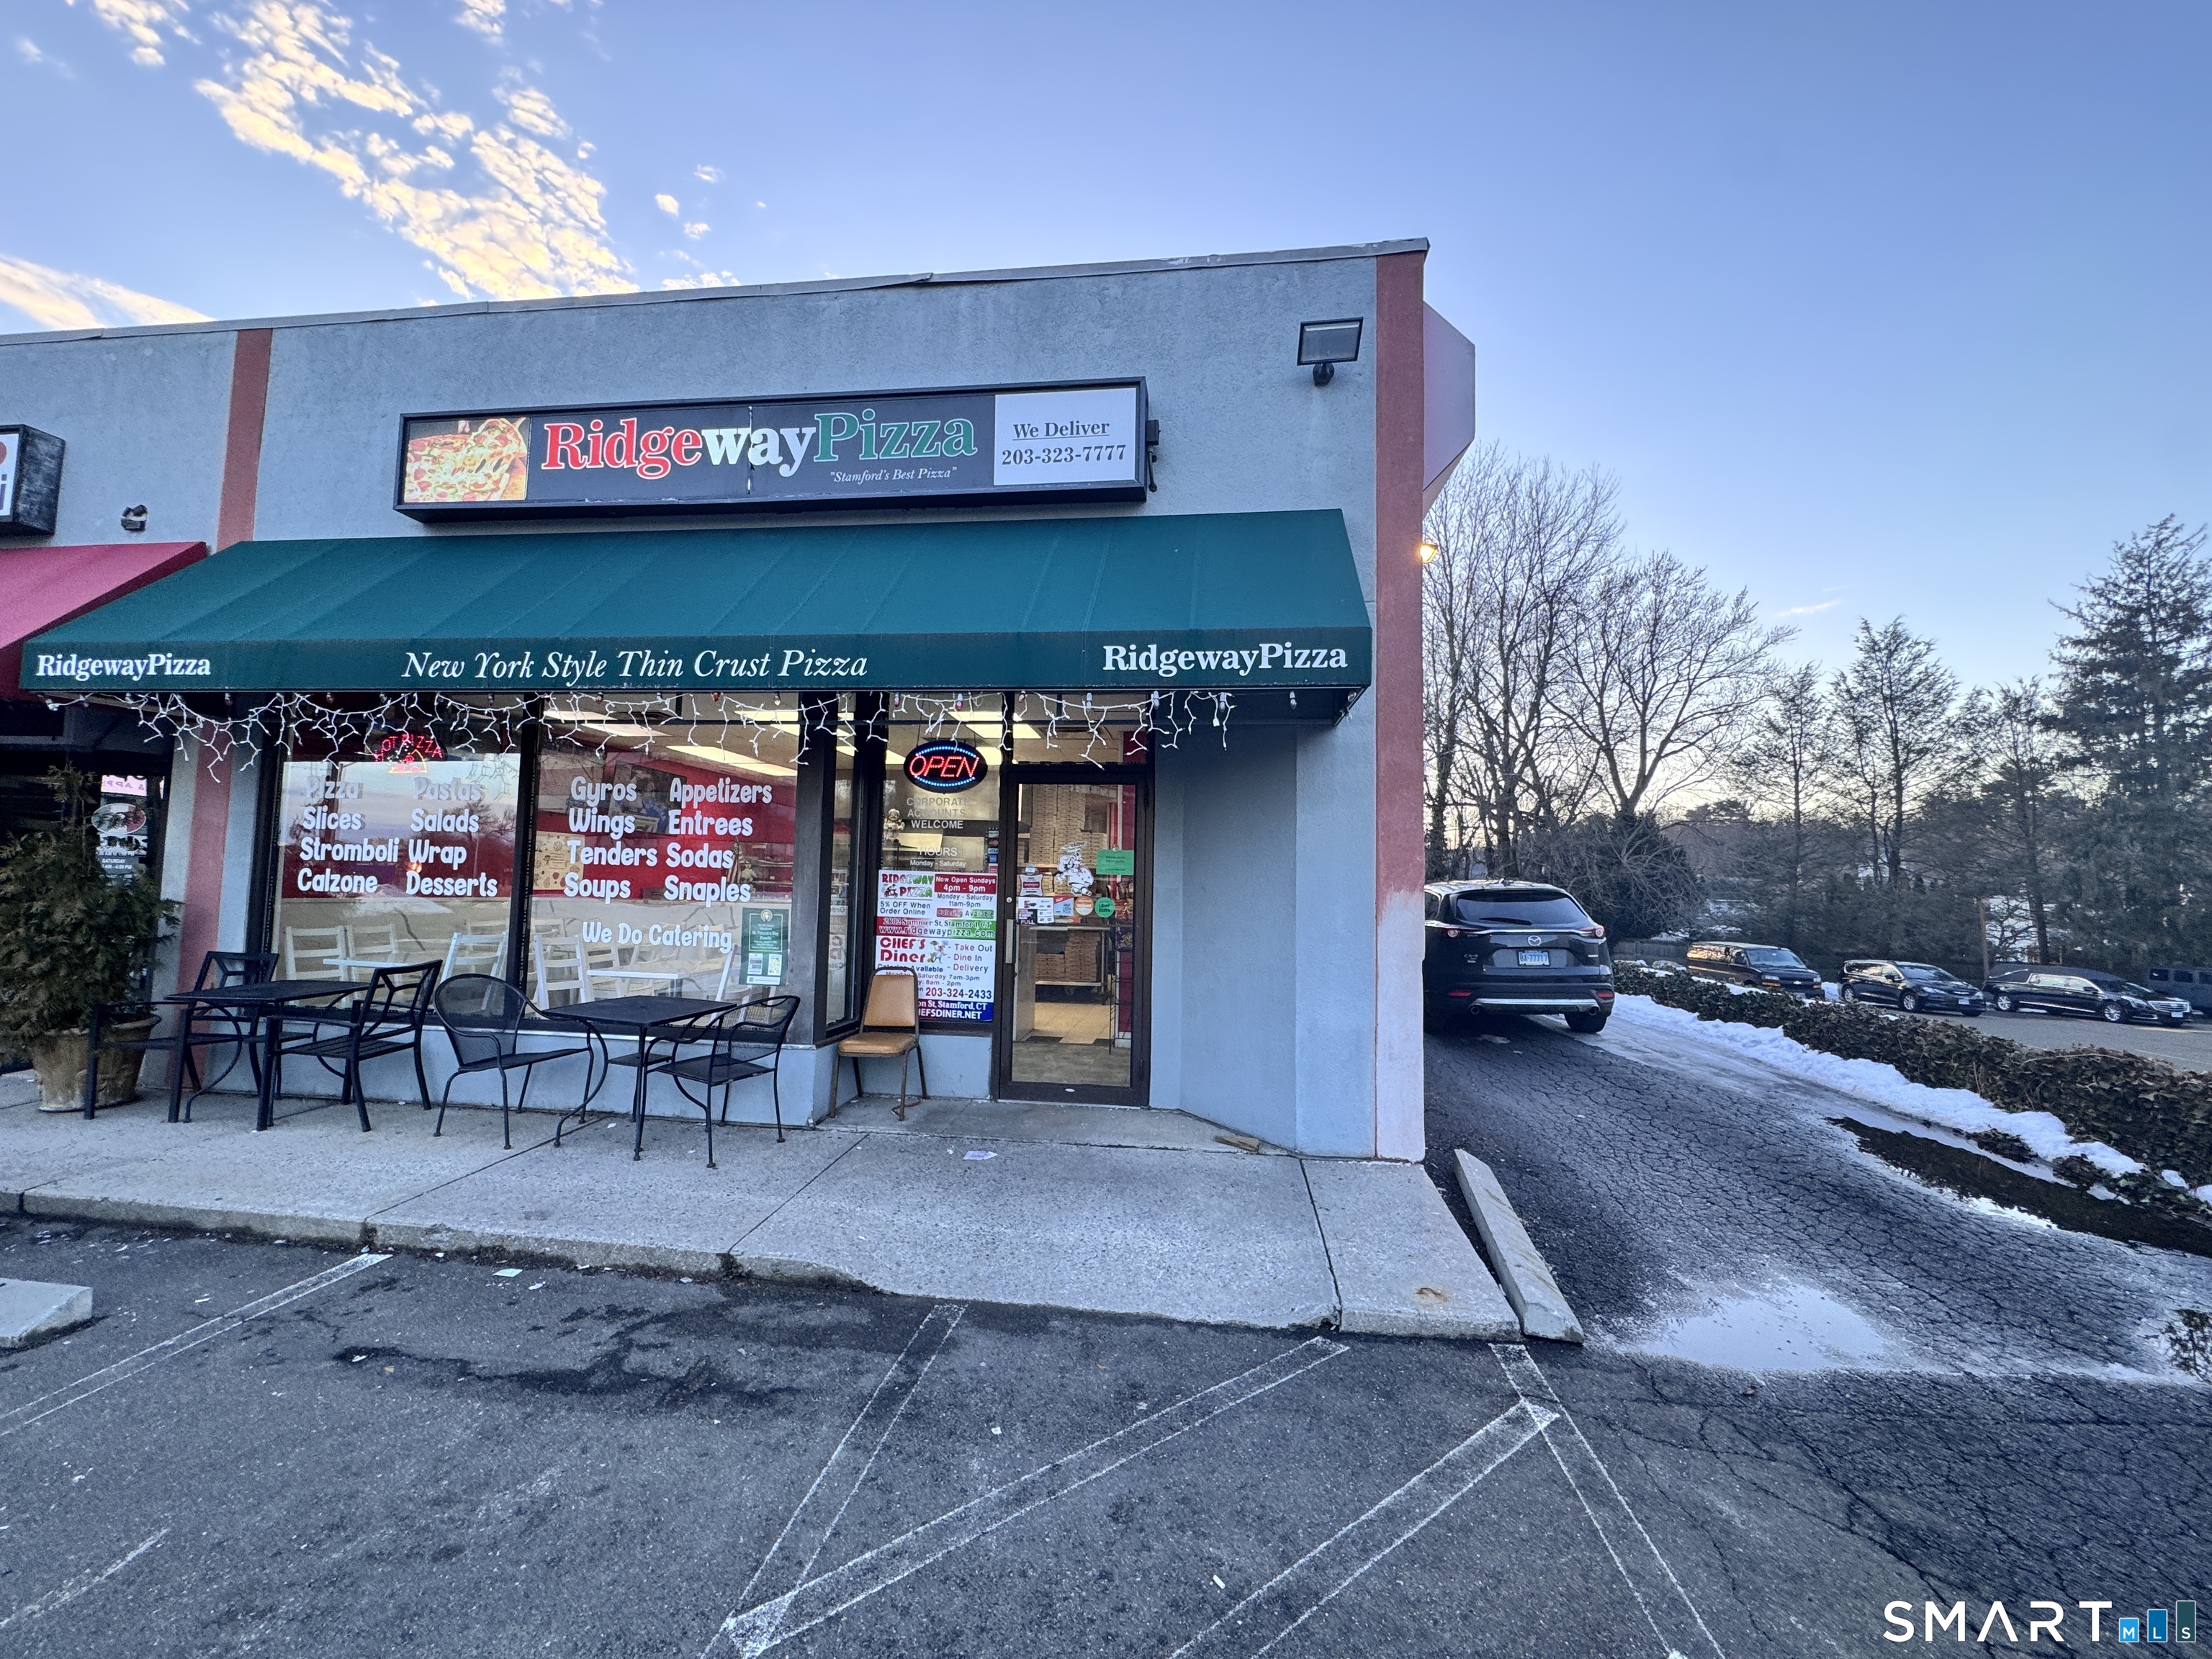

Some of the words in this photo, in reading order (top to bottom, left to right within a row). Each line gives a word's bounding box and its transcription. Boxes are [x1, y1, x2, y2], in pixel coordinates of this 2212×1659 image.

[1013, 423, 1039, 439] We
[1045, 421, 1110, 437] Deliver
[541, 408, 978, 480] RidgewayPizza
[1002, 444, 1127, 465] 203-323-7777
[893, 469, 915, 481] Best
[36, 653, 211, 681] RidgewayPizza
[401, 652, 464, 678] New
[475, 652, 534, 678] York
[541, 649, 607, 687] Style
[617, 649, 683, 678] Thin
[694, 649, 770, 678] Crust
[778, 649, 868, 677] Pizza
[1102, 642, 1348, 678] RidgewayPizza
[373, 735, 399, 763] HOT
[401, 733, 444, 759] PIZZA
[909, 755, 980, 778] OPEN
[306, 775, 361, 800] Pizza
[413, 777, 484, 801] Pastas
[571, 776, 637, 807] Gyros
[670, 778, 773, 809] Appetizers
[907, 797, 971, 806] CORPORATE
[303, 805, 362, 830] Slices
[410, 808, 480, 833] Salads
[568, 807, 636, 840] Wings
[668, 809, 753, 836] Entrees
[911, 820, 964, 830] WELCOME
[300, 837, 399, 863] Stromboli
[408, 839, 467, 871] Wrap
[567, 840, 657, 866] Tenders
[665, 842, 734, 869] Sodas
[919, 847, 958, 857] HOURS
[910, 859, 934, 868] Monday
[939, 860, 967, 868] Saturday
[297, 868, 378, 894] Calzone
[406, 871, 498, 897] Desserts
[881, 873, 934, 884] RIDGEWAY
[564, 872, 631, 904] Soups
[664, 875, 751, 907] Snaples
[899, 886, 932, 898] PIZZA
[943, 884, 961, 892] 4pm
[968, 885, 986, 894] 9pm
[902, 918, 933, 927] Summer
[937, 908, 963, 918] Catering
[965, 909, 994, 917] Available
[583, 921, 612, 943] We
[619, 922, 643, 945] Do
[649, 924, 732, 954] Catering
[878, 925, 995, 938] www.ridgewaypizza.com
[880, 937, 926, 950] CHEF'S
[880, 949, 926, 963] Diner
[953, 963, 989, 973] Delivery
[925, 986, 992, 999] 203-324-2433
